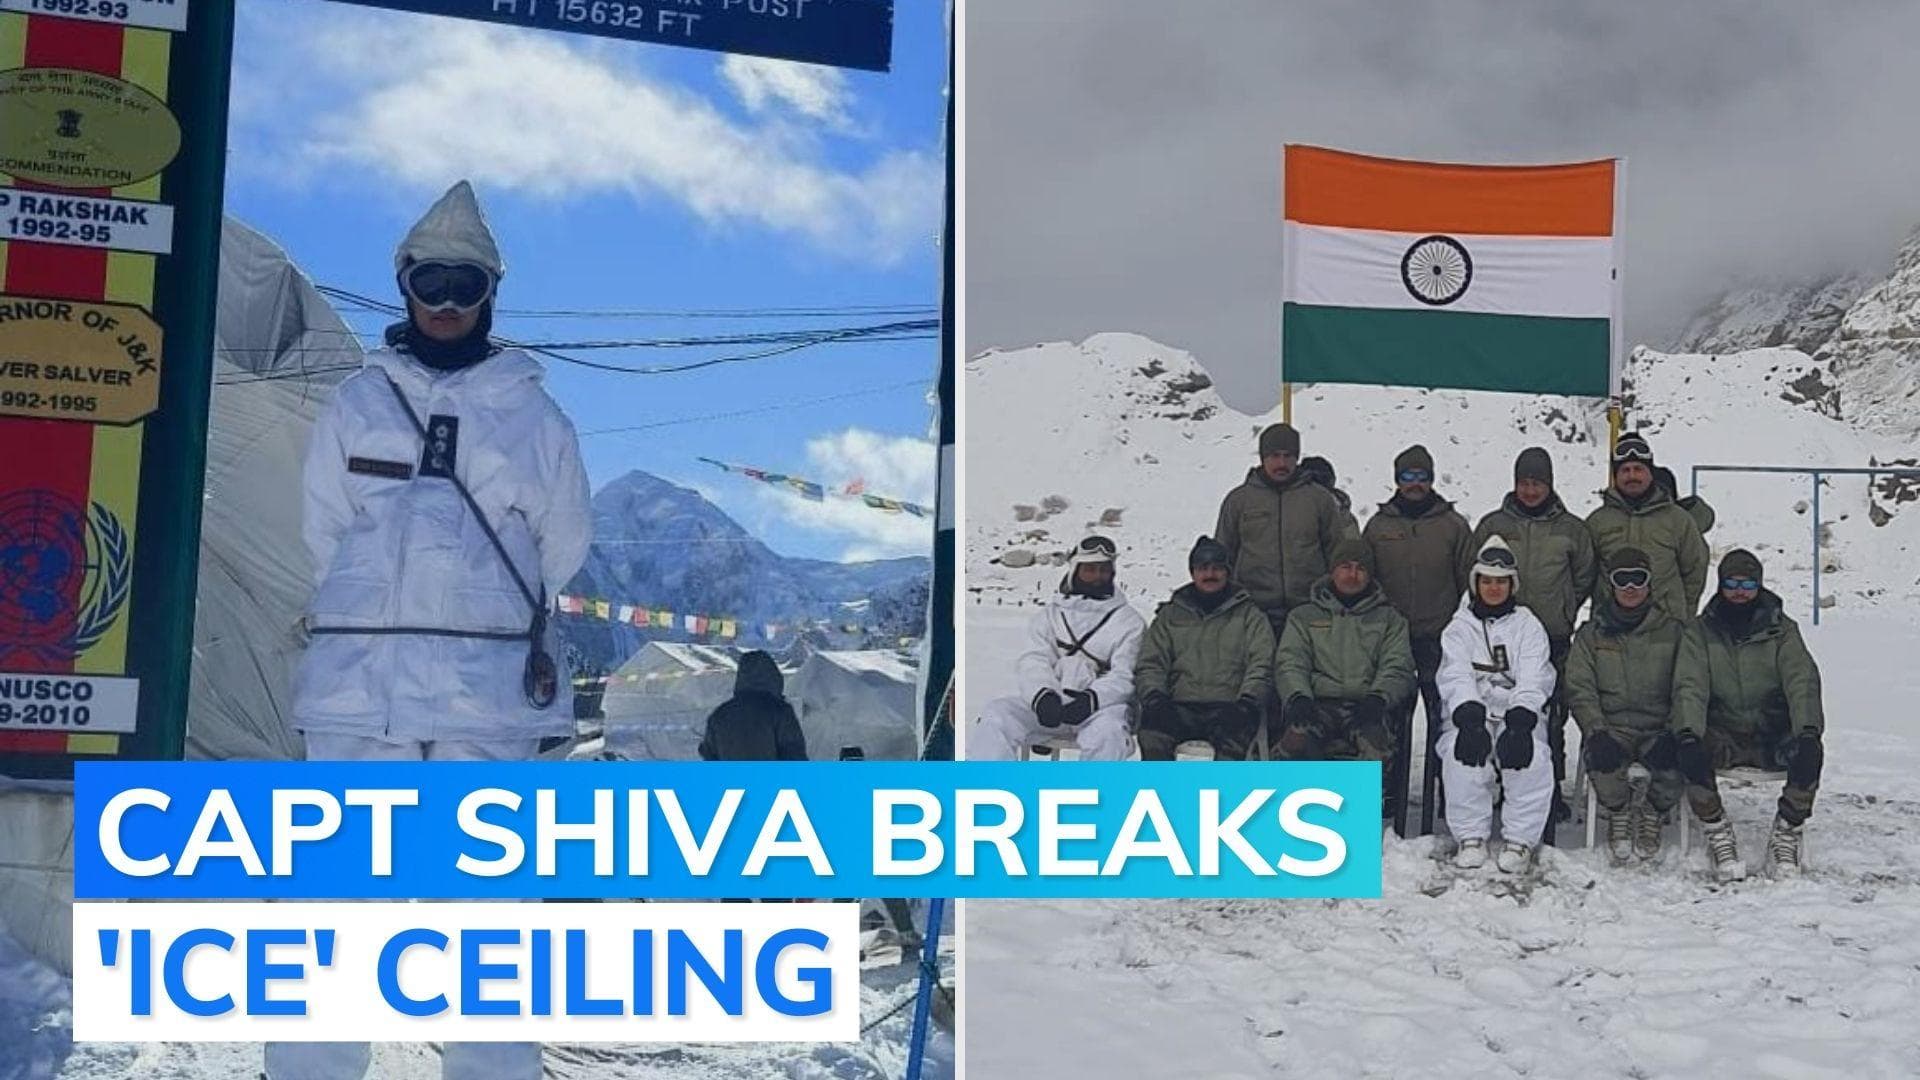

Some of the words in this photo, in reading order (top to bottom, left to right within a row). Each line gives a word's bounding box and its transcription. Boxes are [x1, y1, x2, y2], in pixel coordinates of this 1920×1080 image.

[557, 0, 643, 28] 15632
[657, 9, 700, 36] FT
[20, 196, 149, 225] RAKSHAK
[9, 216, 111, 242] 1992-95
[82, 310, 120, 333] OF
[117, 334, 157, 377] J&K
[44, 364, 132, 387] SALVER
